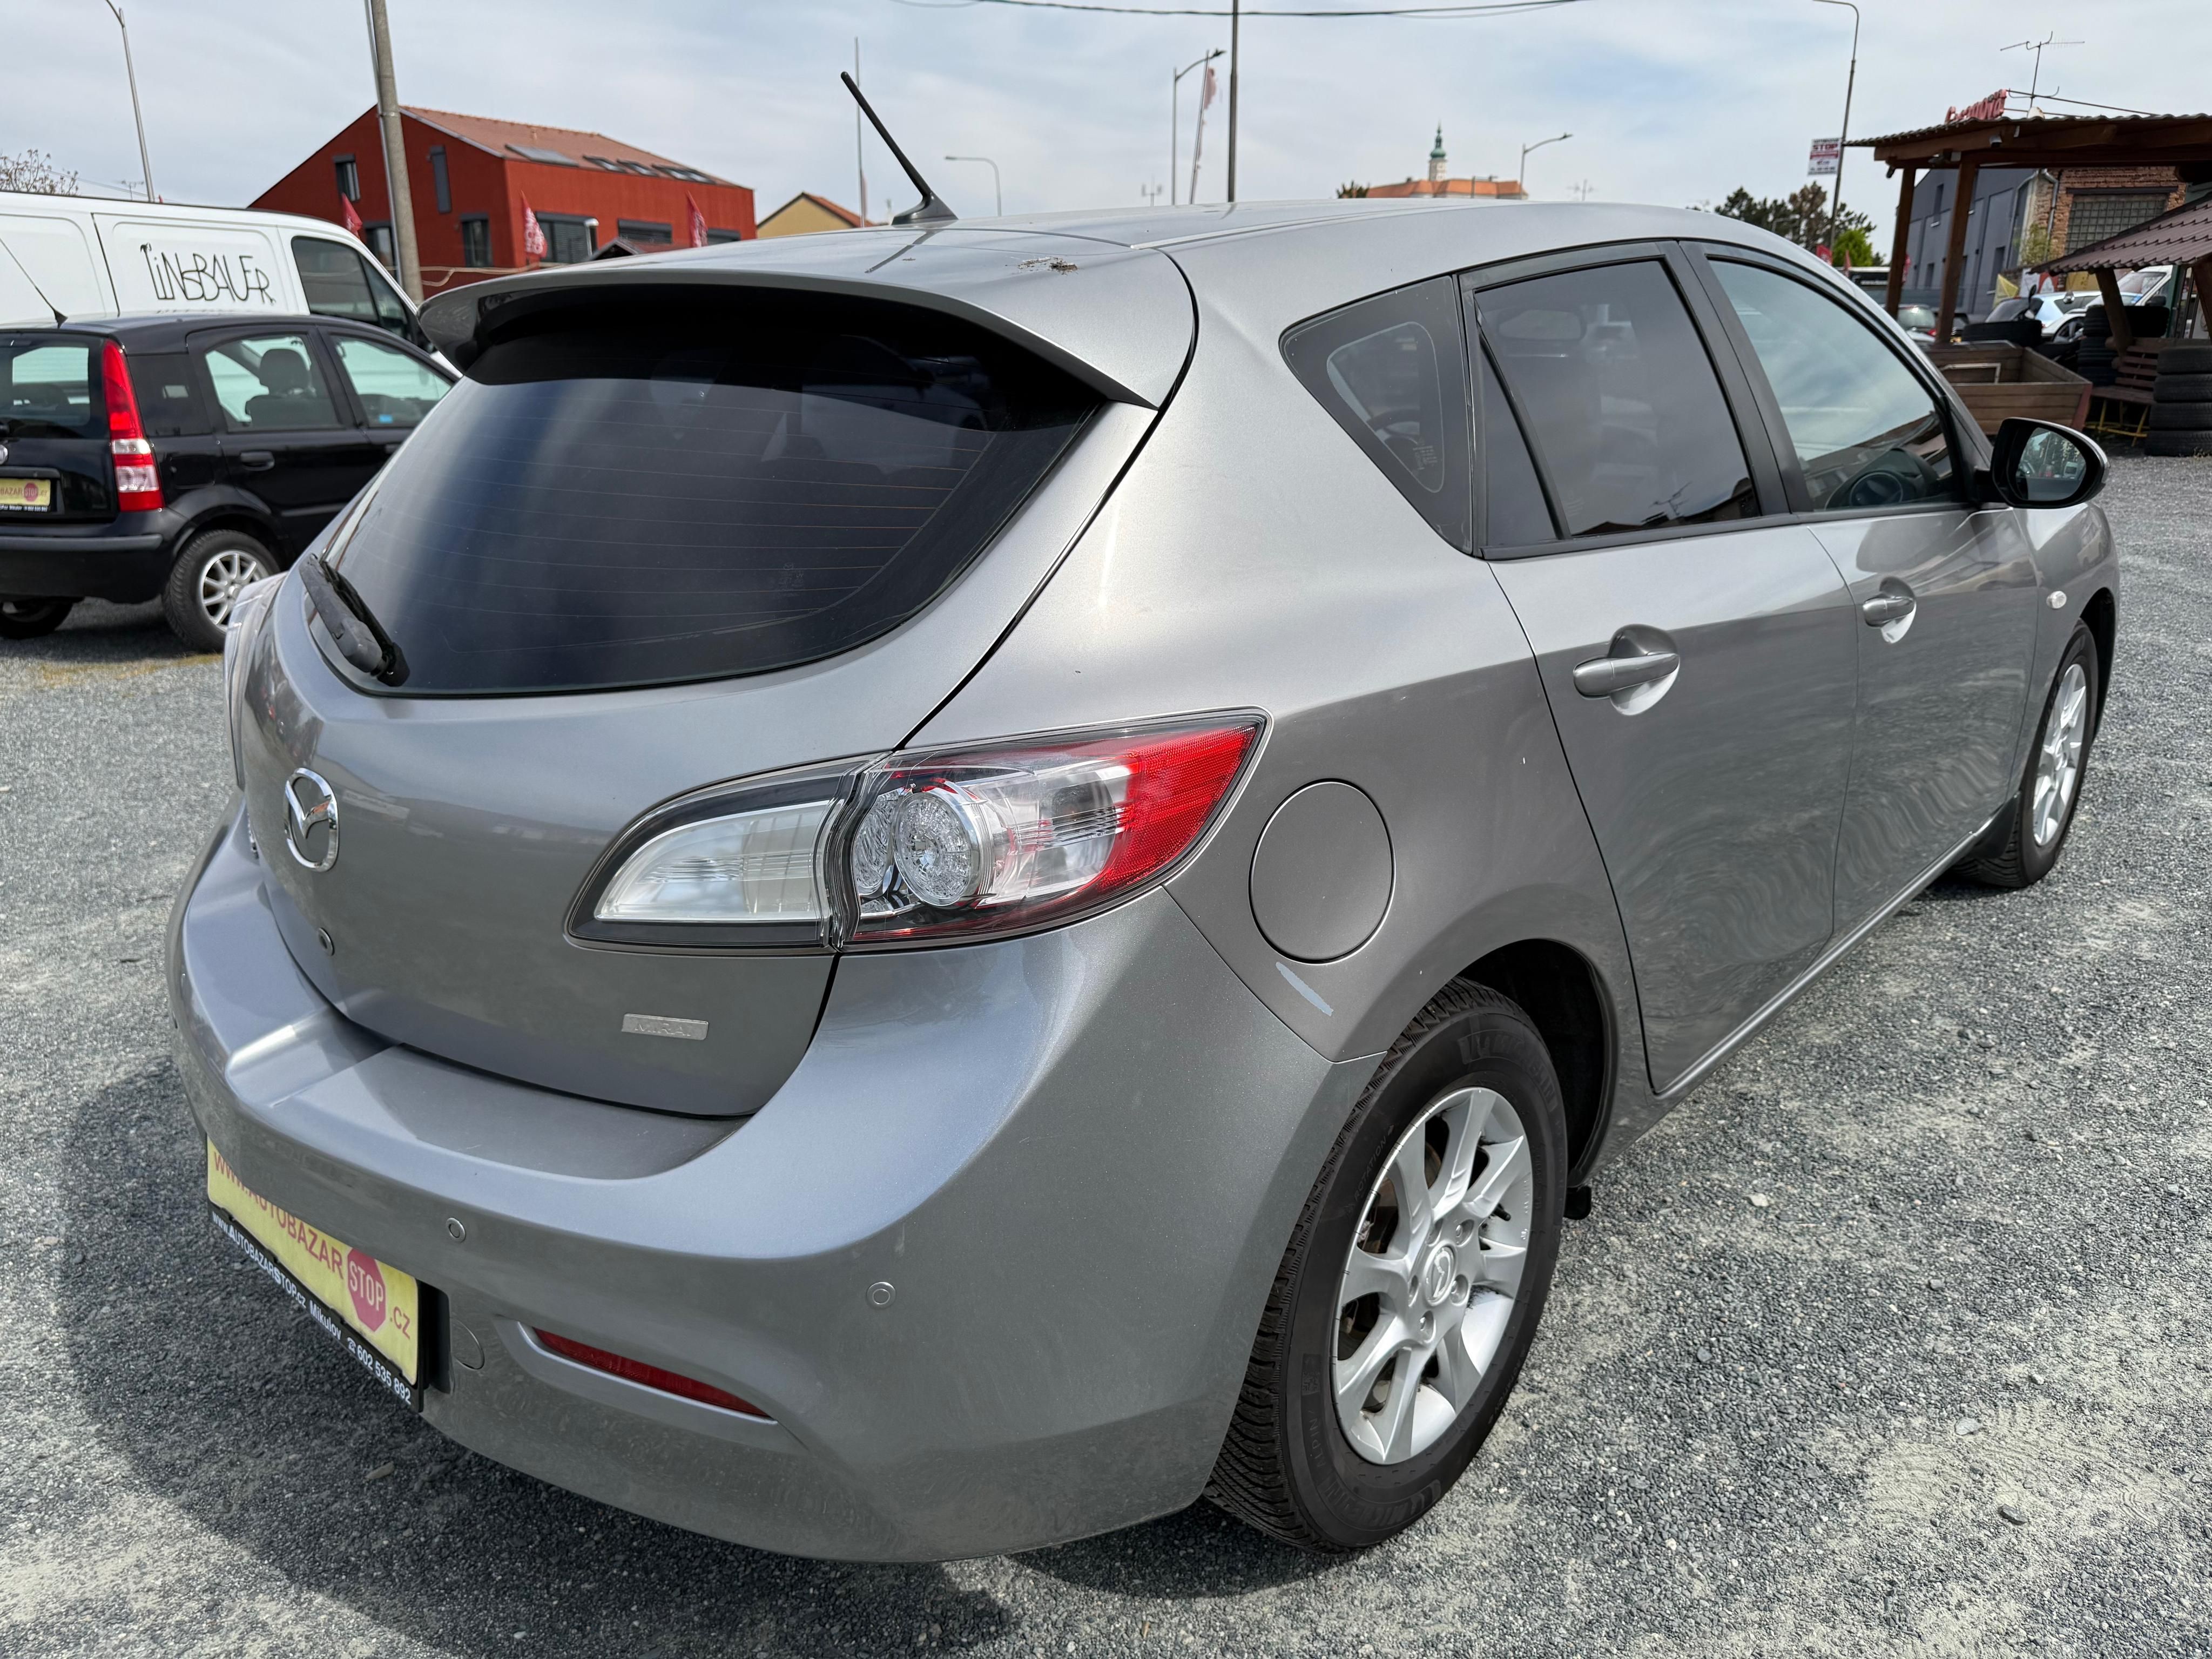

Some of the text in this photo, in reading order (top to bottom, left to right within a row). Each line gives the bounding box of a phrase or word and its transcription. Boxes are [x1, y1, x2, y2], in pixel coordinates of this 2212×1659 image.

[349, 1260, 384, 1311] STOP
[309, 1300, 341, 1340] Mikulov
[357, 1345, 373, 1371] 602
[374, 1360, 392, 1387] 535
[393, 1378, 412, 1405] 892
